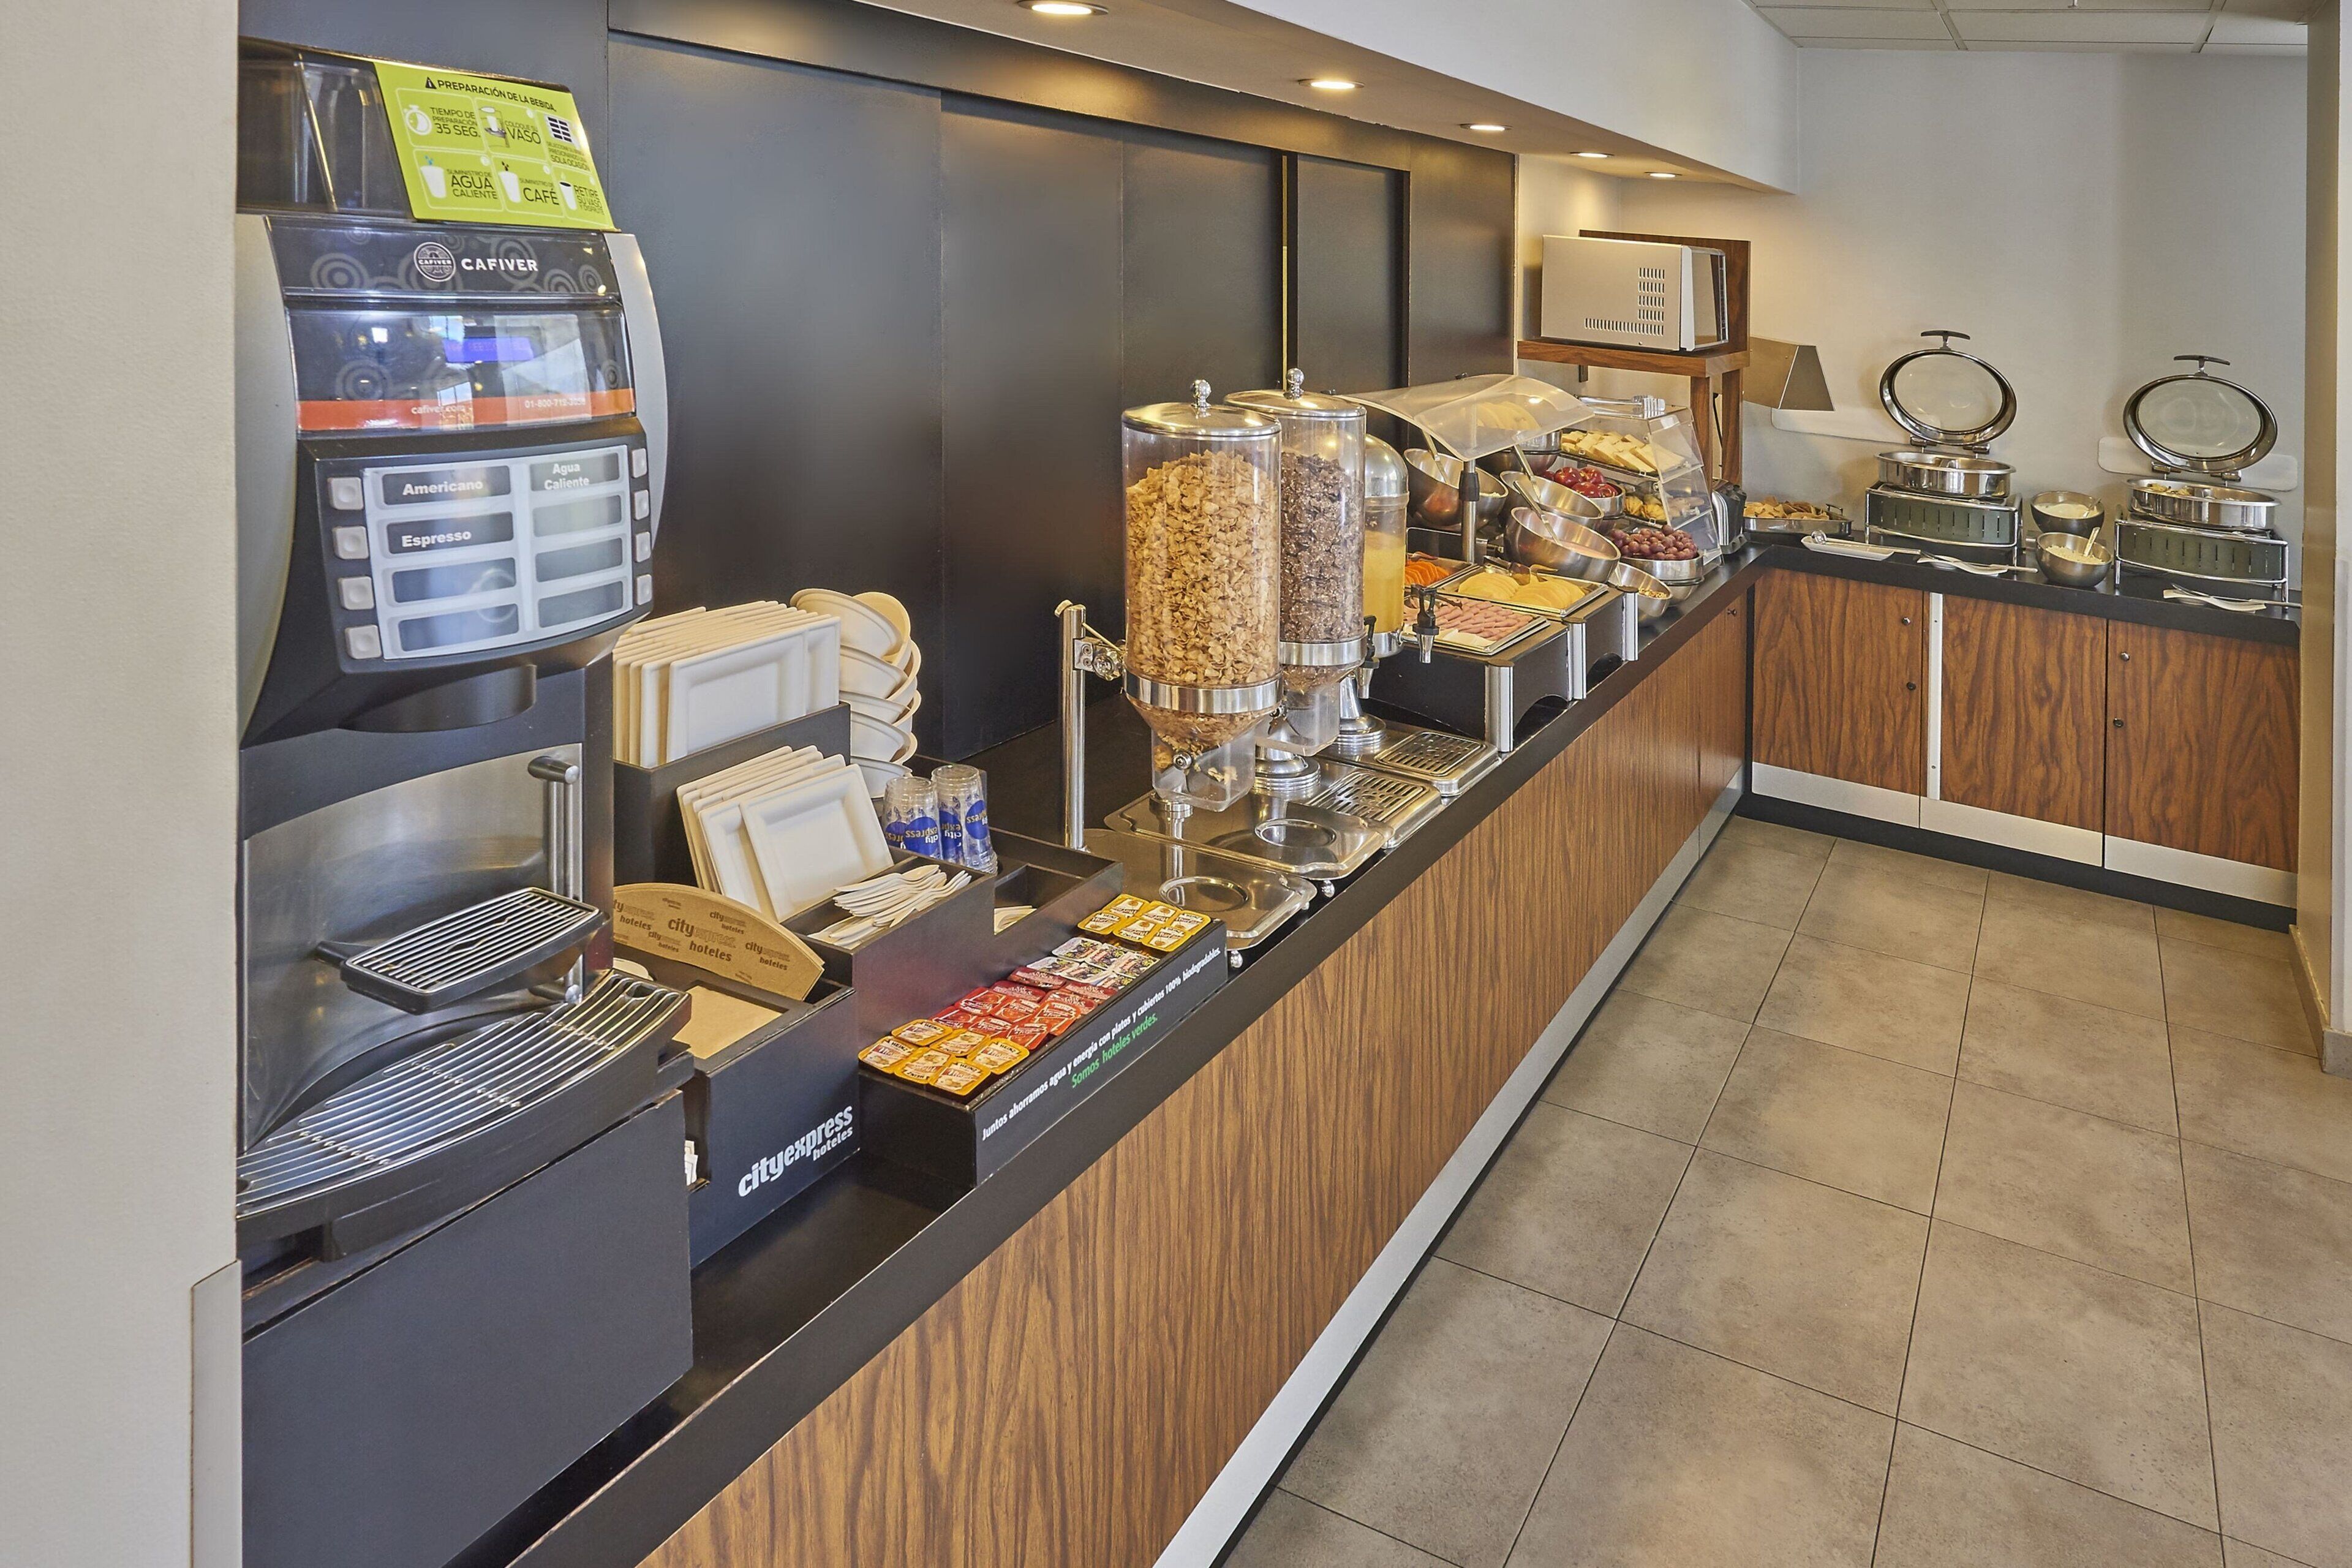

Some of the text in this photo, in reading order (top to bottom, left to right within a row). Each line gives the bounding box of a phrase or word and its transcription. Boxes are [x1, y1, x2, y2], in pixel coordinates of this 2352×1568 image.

[437, 80, 507, 99] PREPARACIÓN
[508, 92, 518, 102] DE
[520, 95, 529, 104] LA
[430, 107, 475, 119] TIEMPO DE
[434, 123, 481, 137] 35 SEG.
[506, 127, 541, 144] VASO
[451, 175, 494, 190] AGUA
[453, 189, 498, 199] CALIENTE
[523, 186, 560, 205] CAFÉ
[461, 258, 538, 271] CAFIVER
[552, 463, 581, 476] Agua
[402, 480, 483, 496] Americano
[544, 476, 590, 491] Caliente
[402, 530, 472, 548] Espresso
[944, 830, 962, 839] city
[619, 915, 652, 930] hoteles
[689, 941, 733, 962] hoteles
[760, 956, 788, 970] hoteles
[982, 947, 1221, 1141] Juntos ahorramos agua y energía con platos y cubiertos 100% biodegradables.
[1000, 1044, 1017, 1053] HEINZ
[1072, 1012, 1158, 1088] Somos hoteles verdes.
[960, 1063, 978, 1072] HEINZ
[813, 1126, 853, 1161] hoteles
